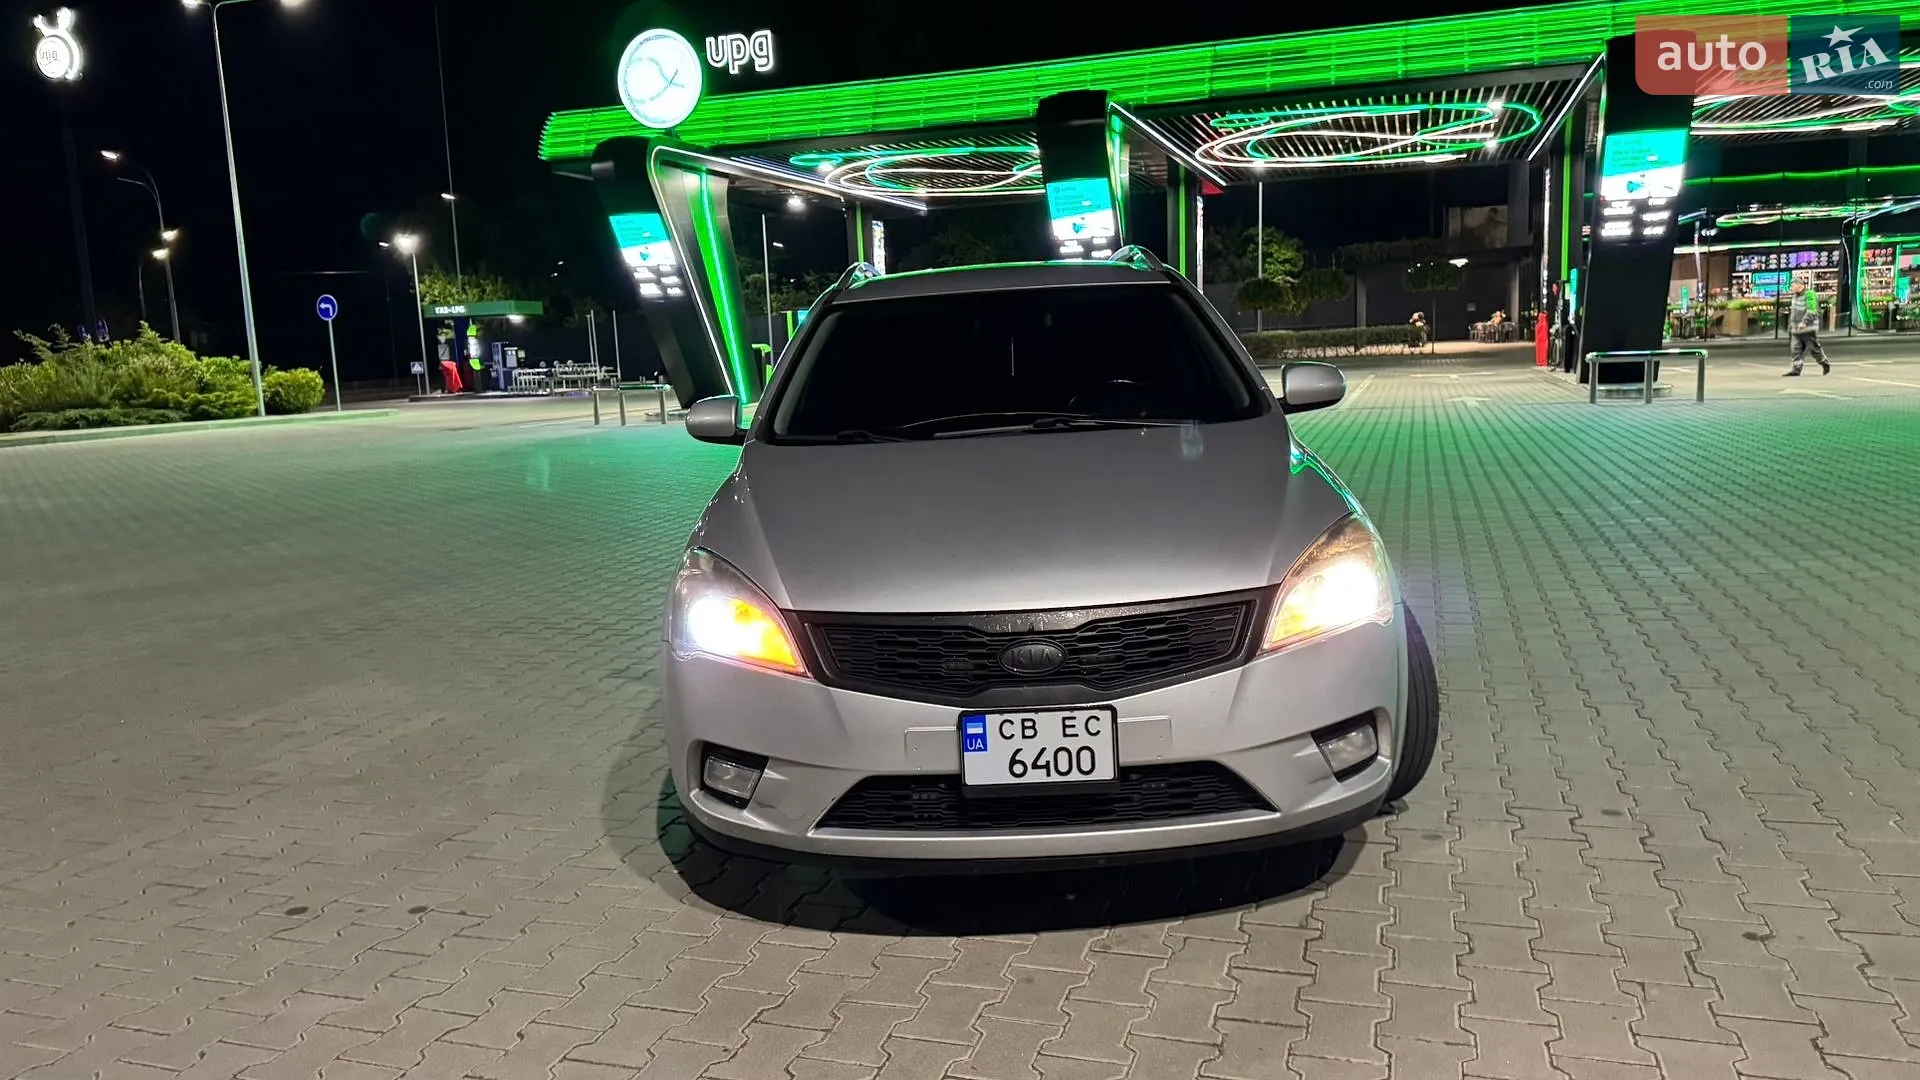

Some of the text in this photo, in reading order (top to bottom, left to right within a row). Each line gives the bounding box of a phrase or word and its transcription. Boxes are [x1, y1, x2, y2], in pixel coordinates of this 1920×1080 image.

[706, 29, 774, 75] upg
[967, 738, 985, 750] UA
[1008, 745, 1096, 779] 6400
